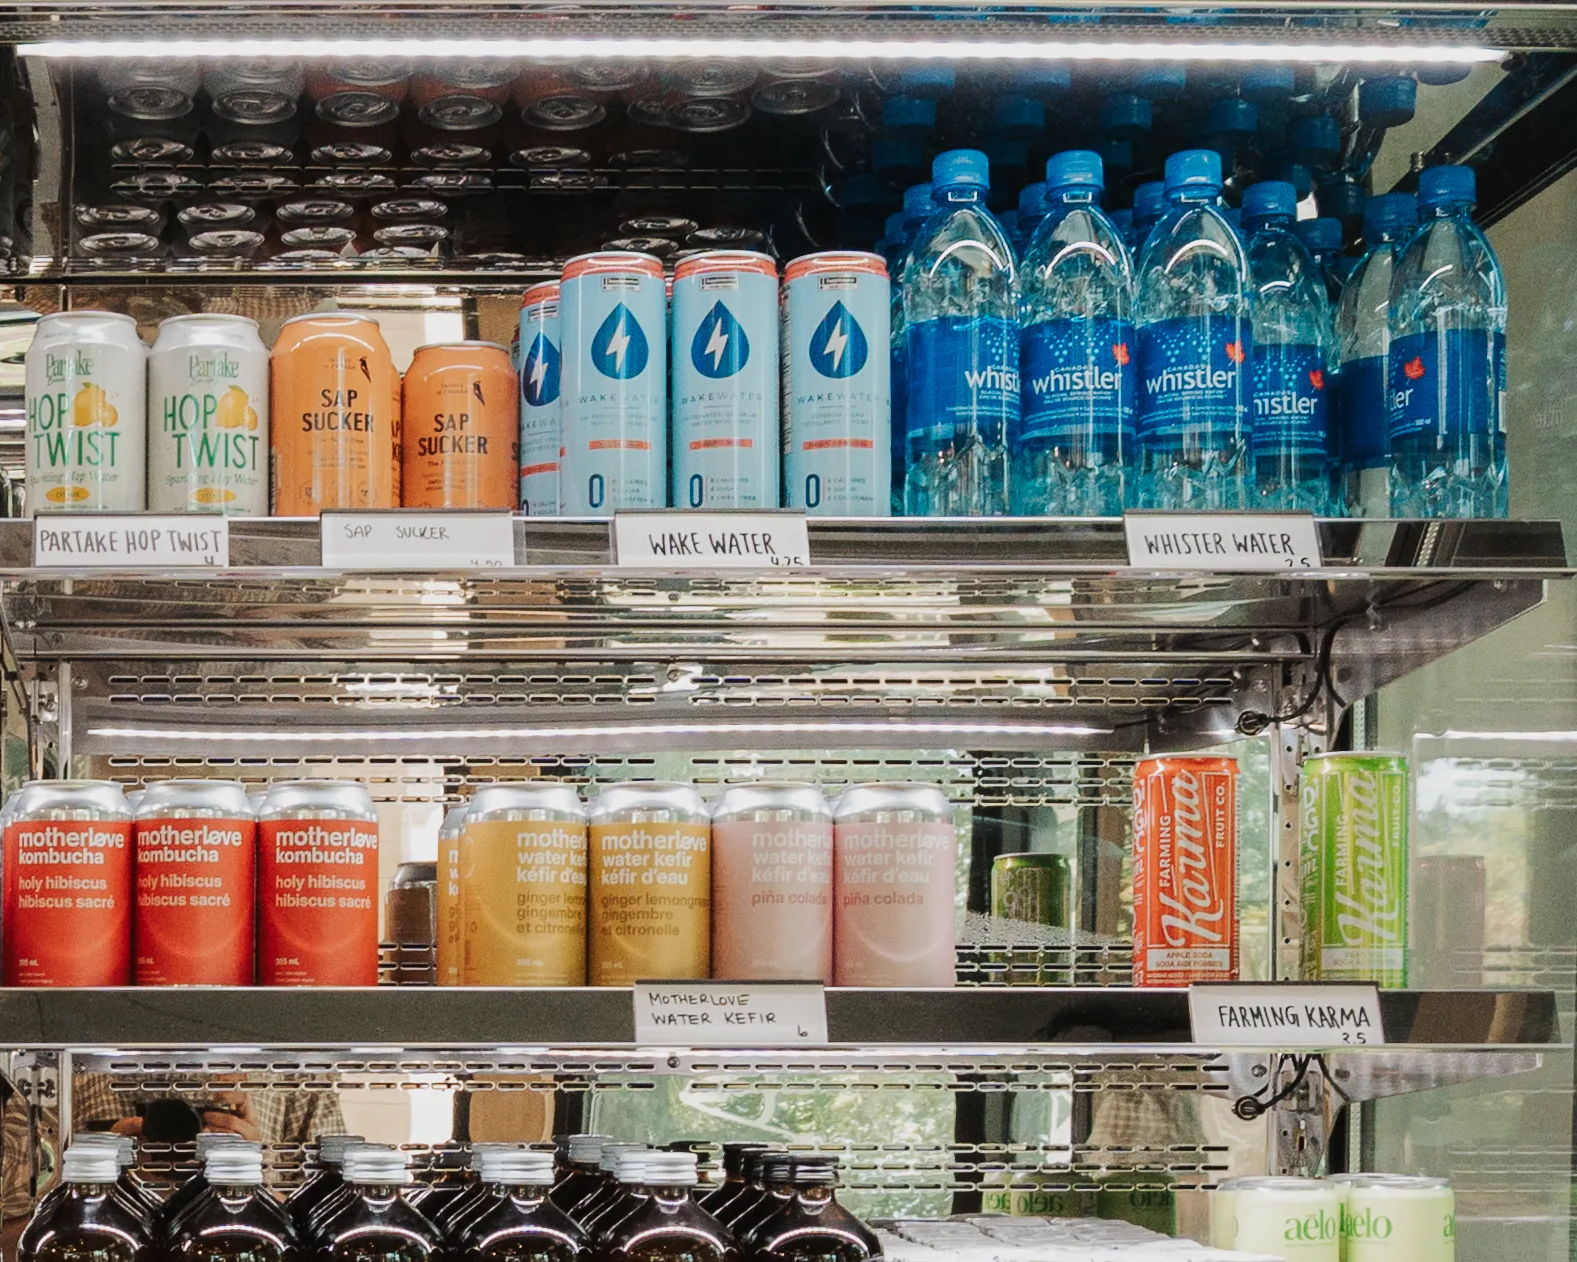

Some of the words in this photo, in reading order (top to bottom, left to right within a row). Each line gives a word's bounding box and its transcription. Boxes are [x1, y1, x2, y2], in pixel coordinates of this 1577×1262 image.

[1145, 367, 1237, 395] whistler
[322, 389, 358, 407] SAP
[164, 393, 218, 431] HOP
[302, 411, 373, 432] SUCKER
[172, 433, 259, 469] TWIST
[40, 529, 118, 553] PARTAKE
[125, 530, 161, 553] HOP
[165, 530, 222, 553] TWIST
[344, 524, 372, 539] SAP
[396, 524, 450, 539] SUCKER
[649, 532, 701, 555] WAKE
[709, 533, 776, 555] WATER
[1144, 532, 1225, 555] WHISTER
[1233, 533, 1295, 555] WATER
[1216, 781, 1226, 798] CO.
[1215, 804, 1226, 849] FRUIT
[276, 847, 364, 865] kombucha
[602, 850, 650, 867] water
[653, 850, 692, 868] kefir
[1159, 814, 1171, 887] FARMING
[1160, 767, 1223, 948] Karma
[276, 877, 304, 890] holy
[307, 875, 366, 890] hibiscus
[601, 867, 637, 887] kéfir
[641, 867, 688, 886] d'eau
[843, 890, 870, 907] piña
[873, 891, 924, 905] colada
[648, 993, 750, 1006] MOTHERLOVE
[652, 1012, 711, 1026] WATER
[724, 1011, 777, 1025] KEFIR
[1219, 1005, 1300, 1028] FARMING
[1307, 1005, 1371, 1028] KARMA
[798, 1025, 808, 1038] 6
